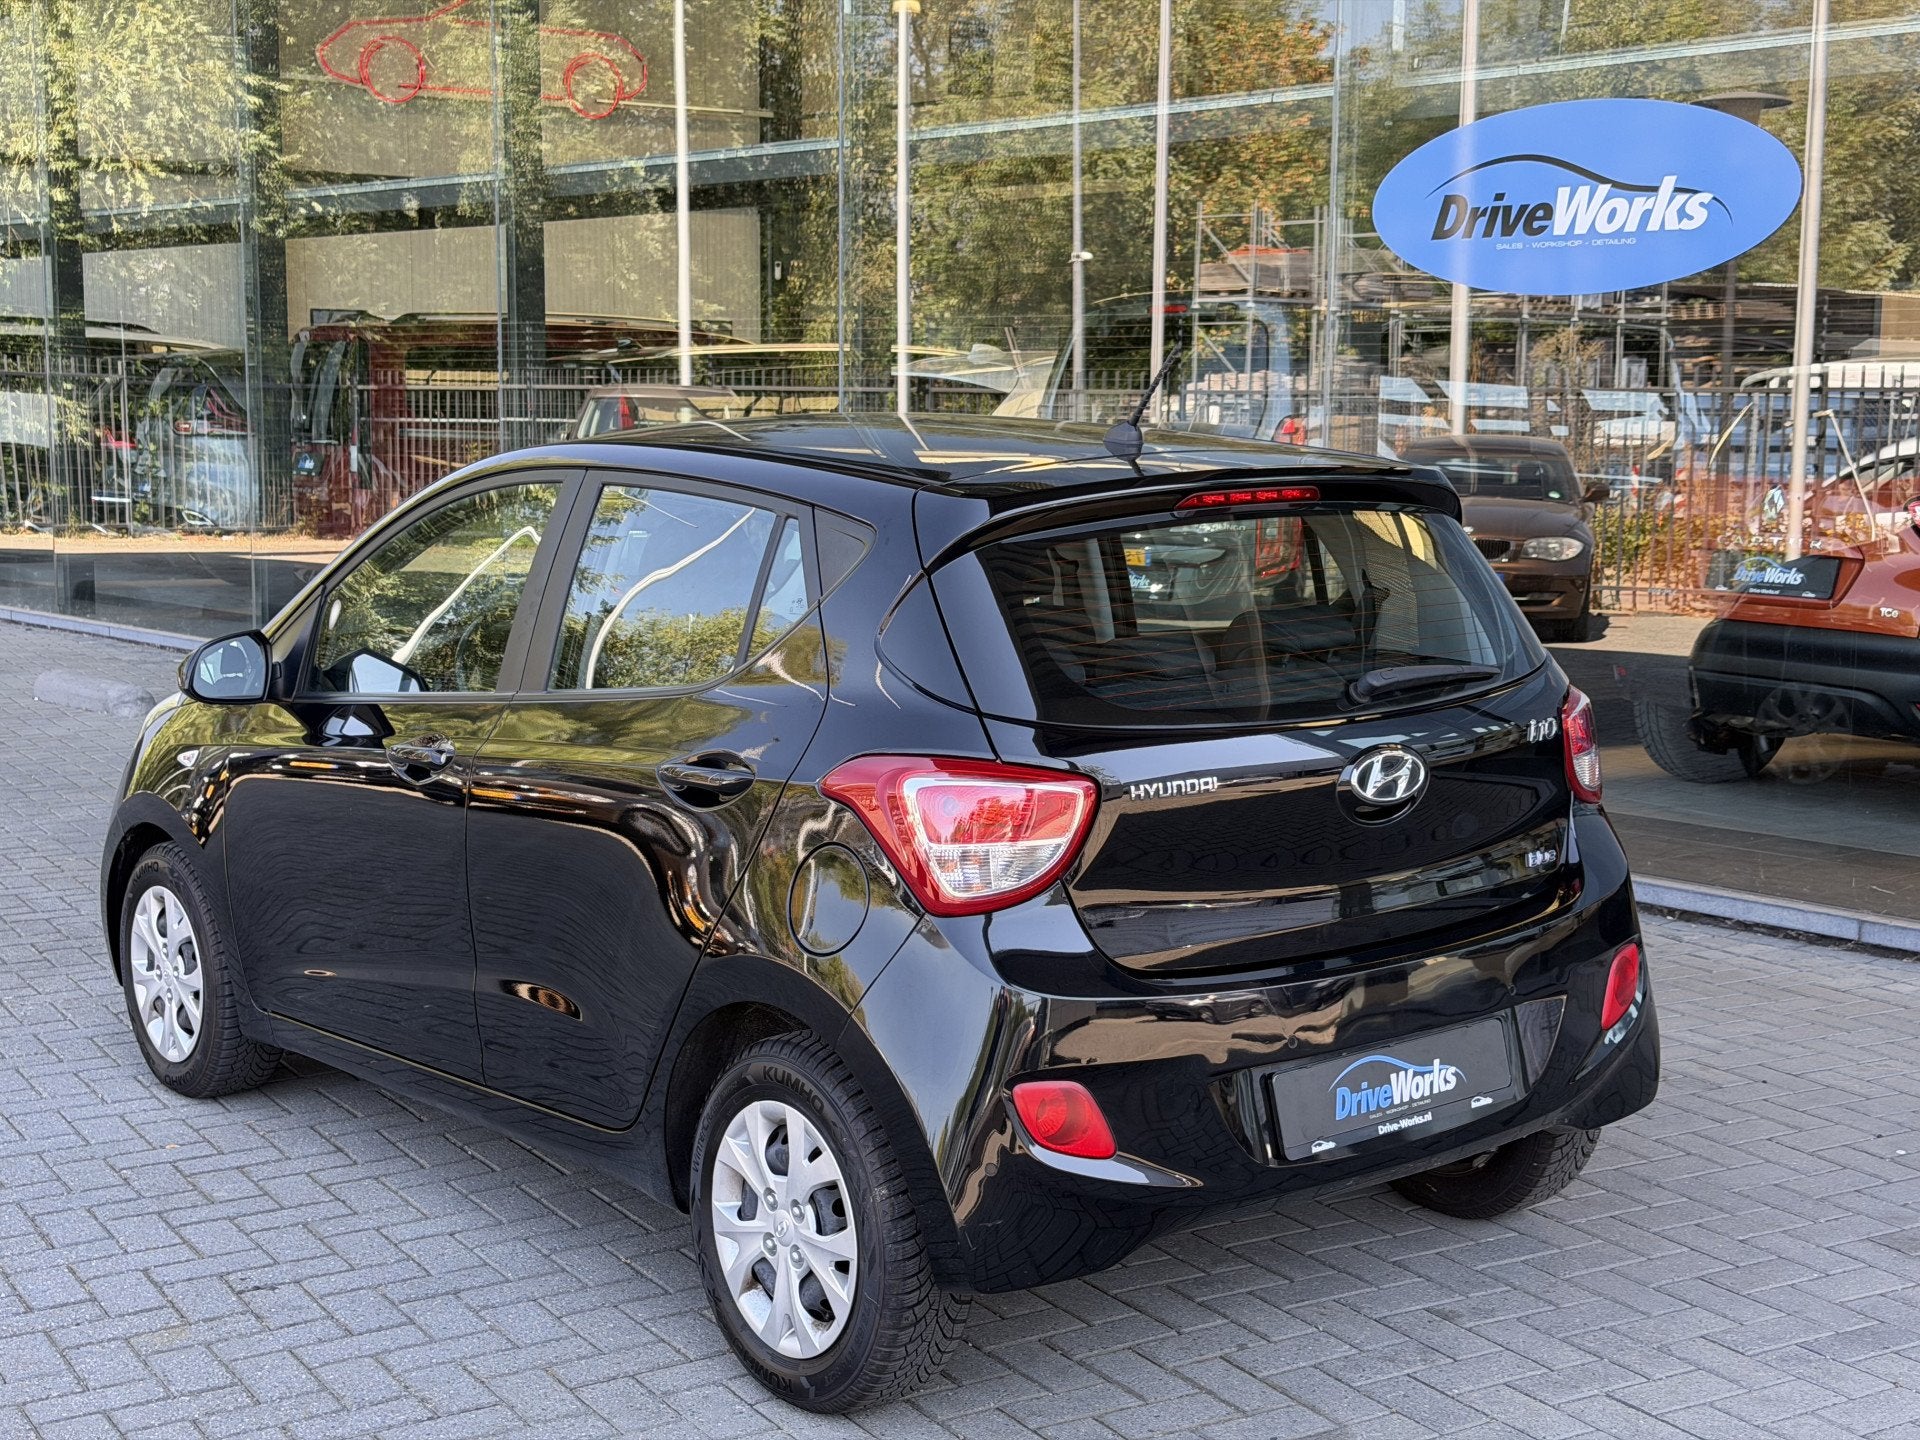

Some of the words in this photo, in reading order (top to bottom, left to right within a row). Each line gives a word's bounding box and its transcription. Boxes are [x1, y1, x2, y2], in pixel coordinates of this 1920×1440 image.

[1430, 175, 1714, 241] DriveWorks
[1496, 242, 1523, 250] SALES
[1531, 240, 1583, 249] WORKSHOP
[1591, 237, 1637, 246] DETAILING
[1734, 565, 1804, 585] DriveWorks
[1130, 776, 1218, 800] HYUNDAI
[762, 1066, 825, 1114] KUMHO
[1335, 1058, 1456, 1120] DriveWorks
[1378, 1111, 1433, 1135] Drive-Works.nl
